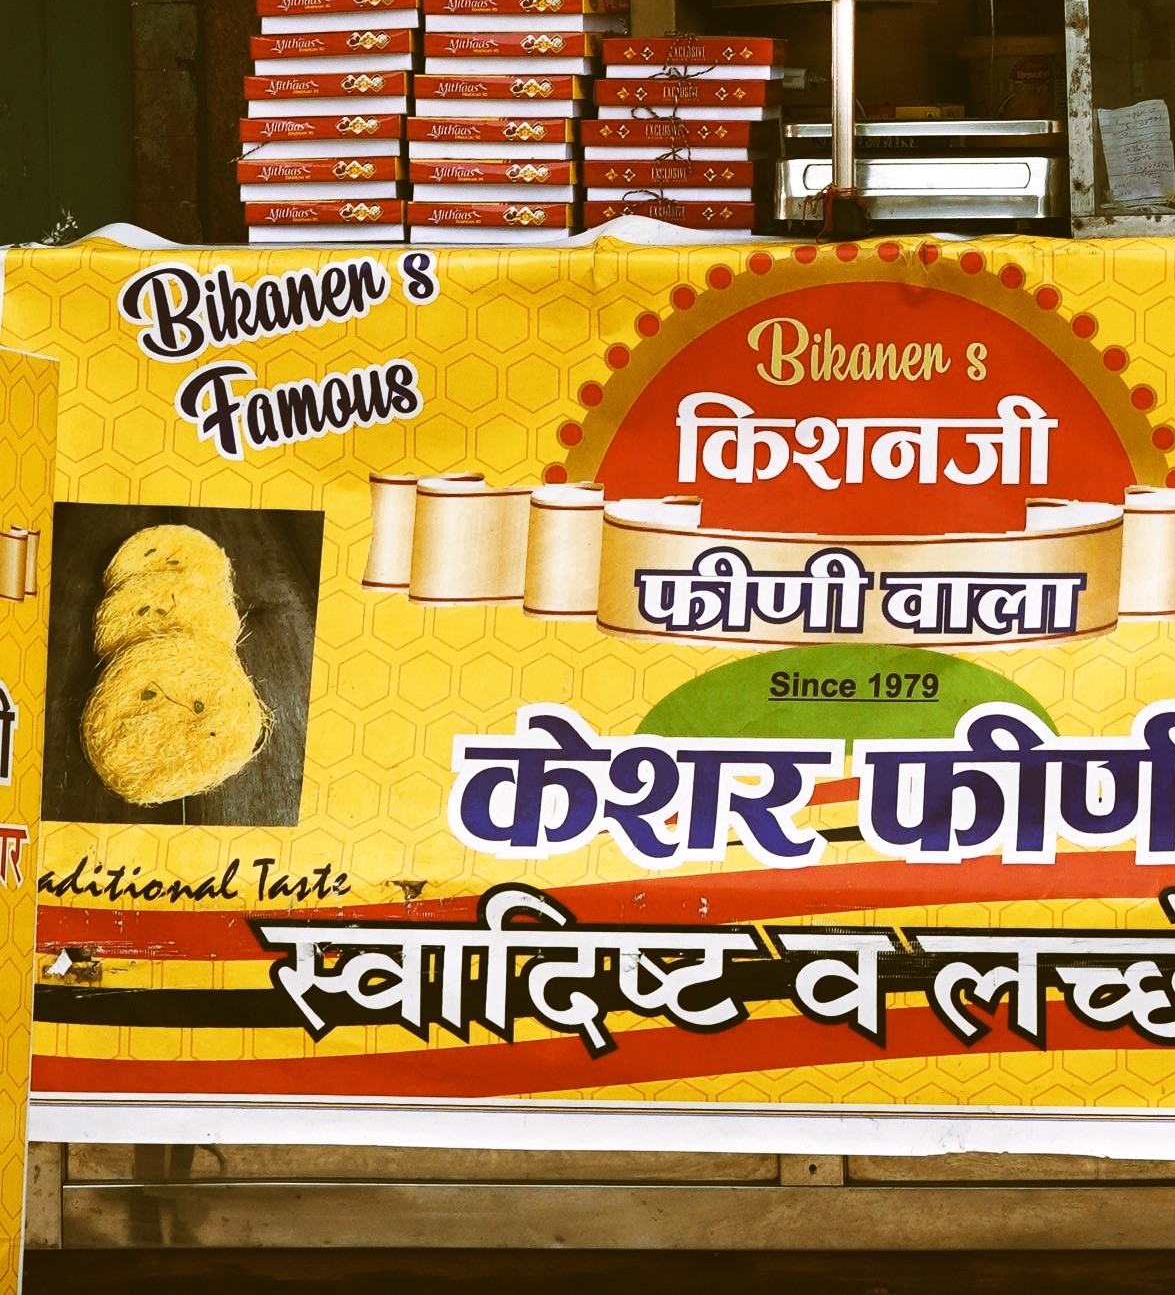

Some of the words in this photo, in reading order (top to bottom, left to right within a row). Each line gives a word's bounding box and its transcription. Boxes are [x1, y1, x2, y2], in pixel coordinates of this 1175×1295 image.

[270, 37, 325, 53] Mithaas
[445, 37, 498, 53] Mithaas
[264, 79, 319, 96] Mithaas
[434, 80, 488, 97] Mithaas
[260, 120, 316, 137] Mithaas
[427, 123, 481, 140] Mithaas
[257, 164, 311, 181] Mithaas
[429, 166, 483, 182] Mithaas
[265, 207, 318, 223] Mithaas
[428, 208, 482, 225] Mithaas
[121, 259, 386, 358] Bikaner
[747, 317, 951, 386] Bikaner
[180, 364, 419, 456] Famous
[676, 392, 1058, 490] किशनजी
[635, 547, 874, 634] फीणी
[881, 571, 1087, 634] वाला
[770, 671, 856, 698] Since
[868, 671, 939, 698] 1979
[459, 714, 830, 858] केशर
[38, 856, 240, 901] aditional
[252, 858, 351, 902] Taste
[254, 886, 762, 1055] स्वादिष्ट
[776, 928, 890, 1046] व
